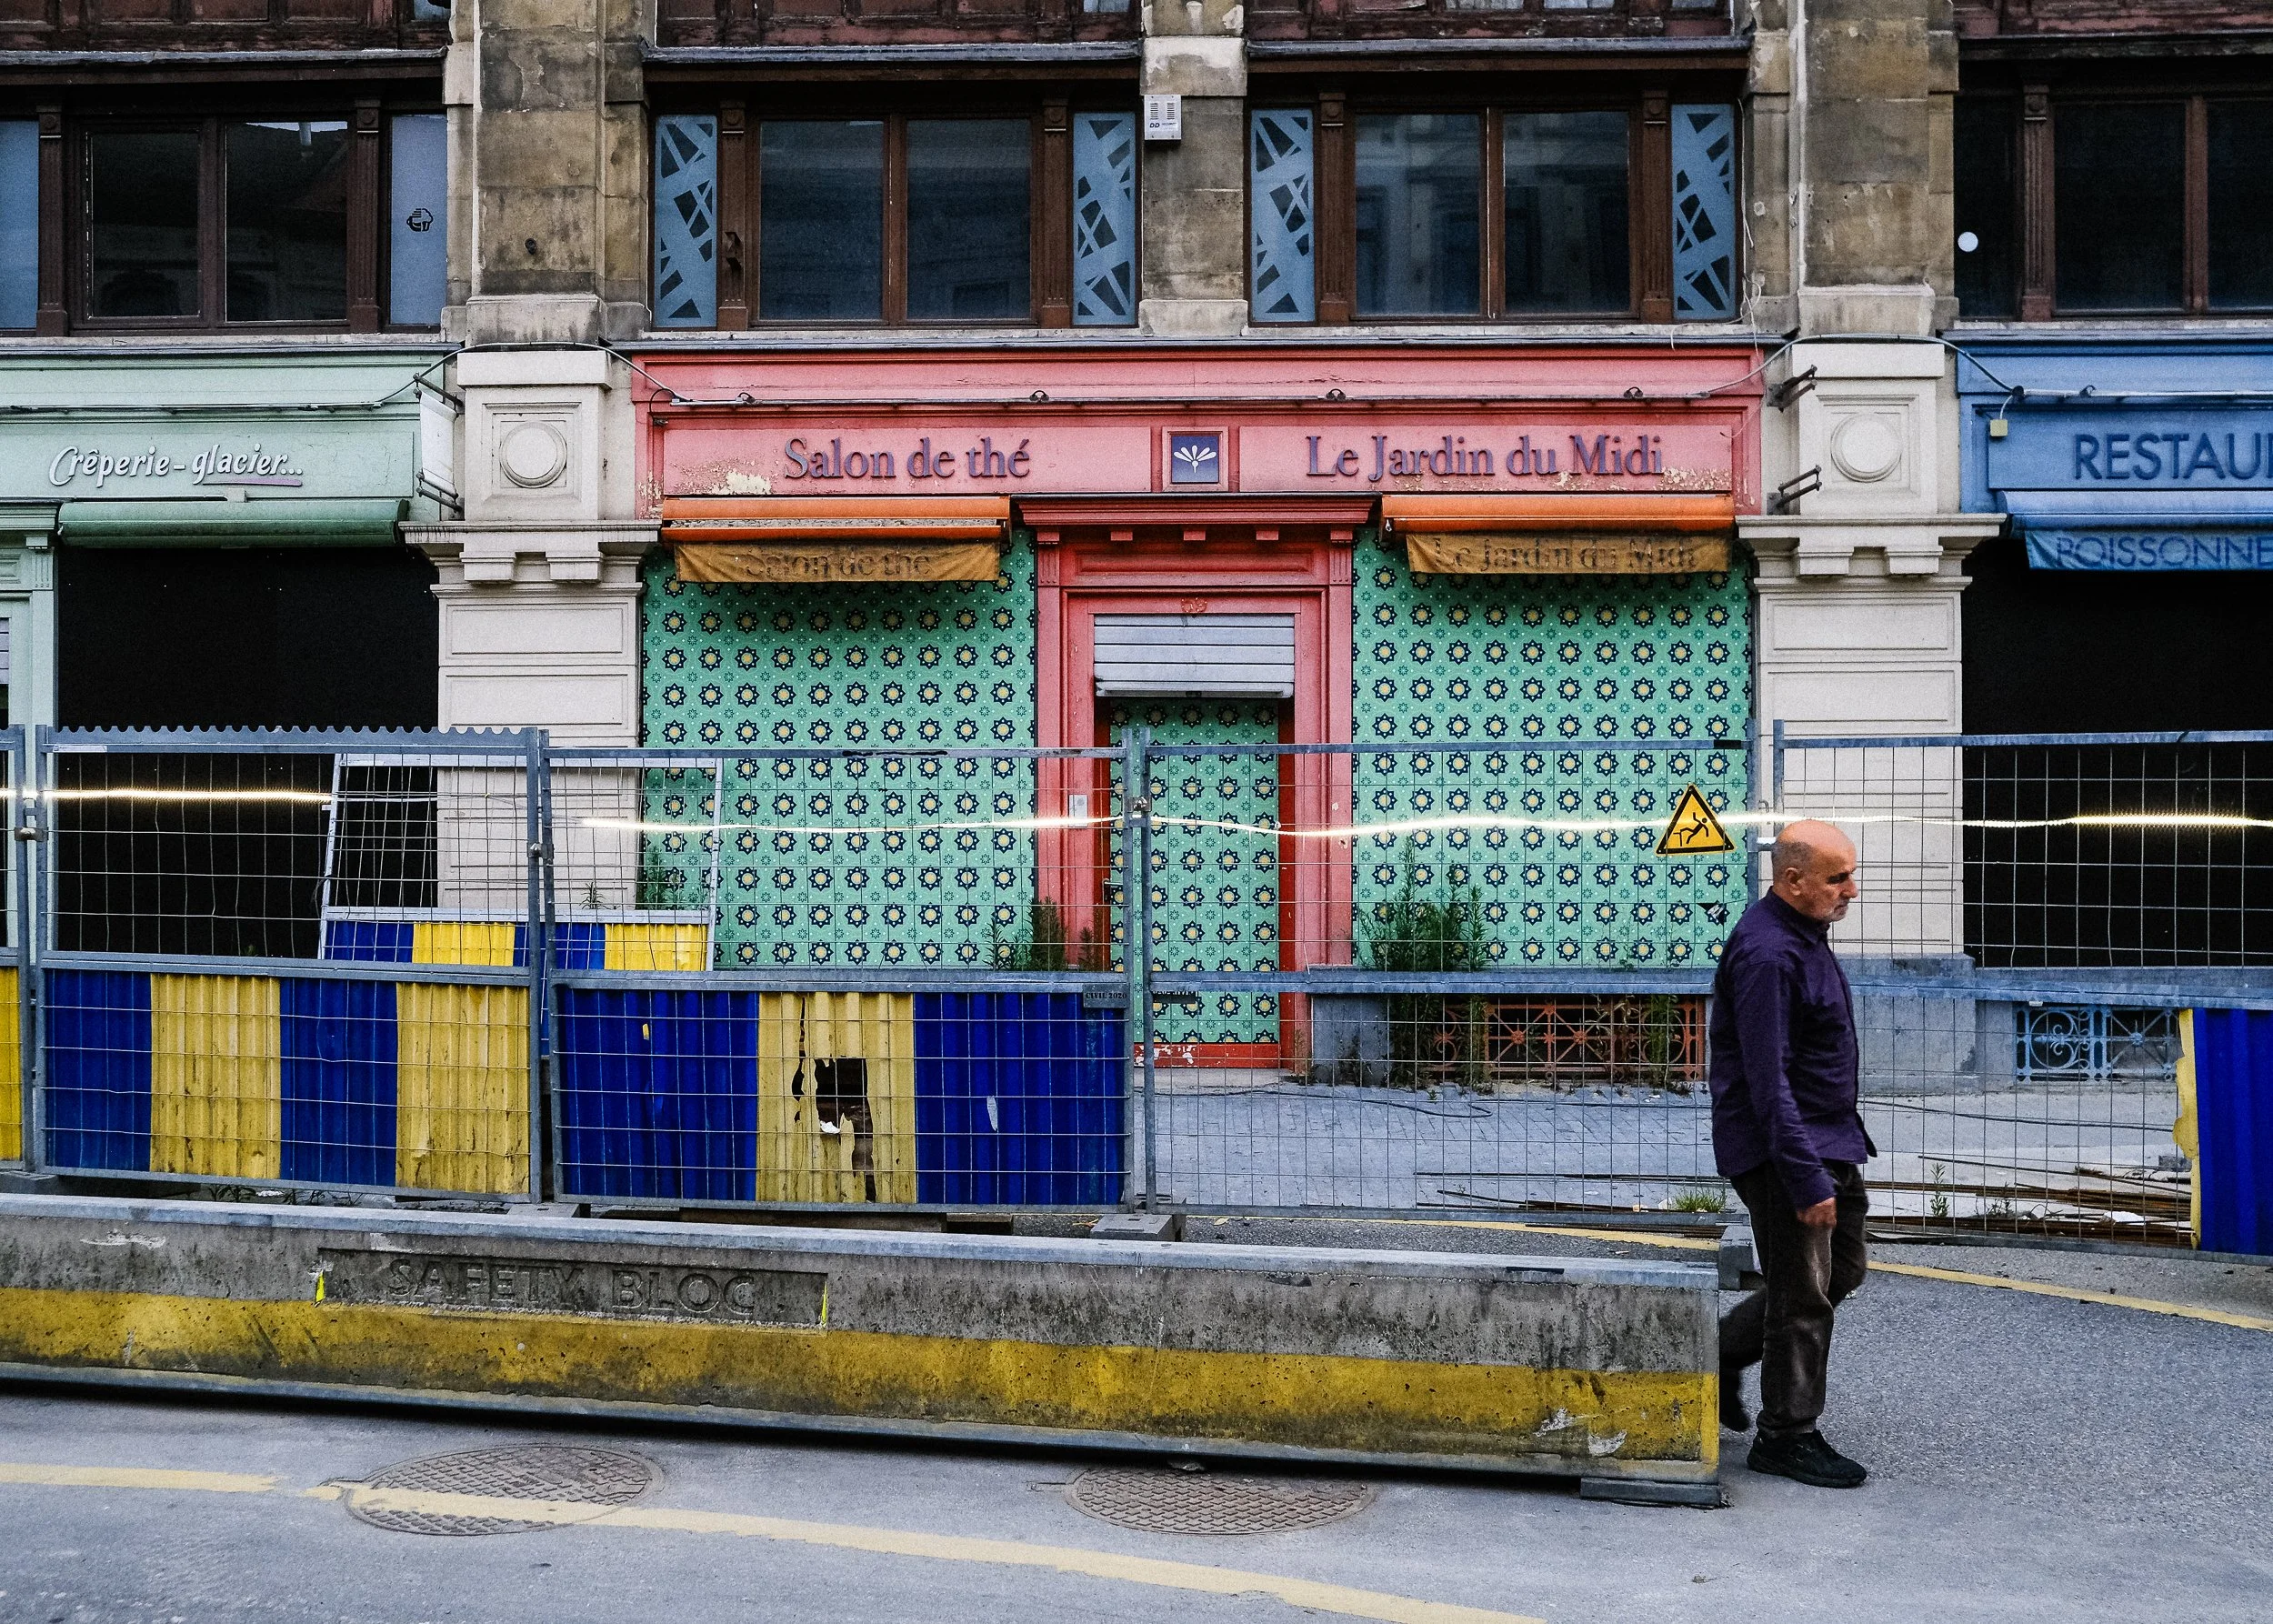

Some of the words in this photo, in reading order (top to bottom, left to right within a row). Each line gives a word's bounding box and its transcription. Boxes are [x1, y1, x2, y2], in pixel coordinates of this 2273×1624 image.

[784, 437, 896, 480] Salon
[908, 436, 956, 479] de
[966, 436, 1030, 479] thé
[1305, 436, 1359, 477] Le
[1367, 434, 1496, 483] Jardin
[1507, 434, 1561, 477] du
[1569, 434, 1665, 477] Midi
[2074, 432, 2273, 481] RESTAU
[386, 1258, 585, 1308] SAFETY
